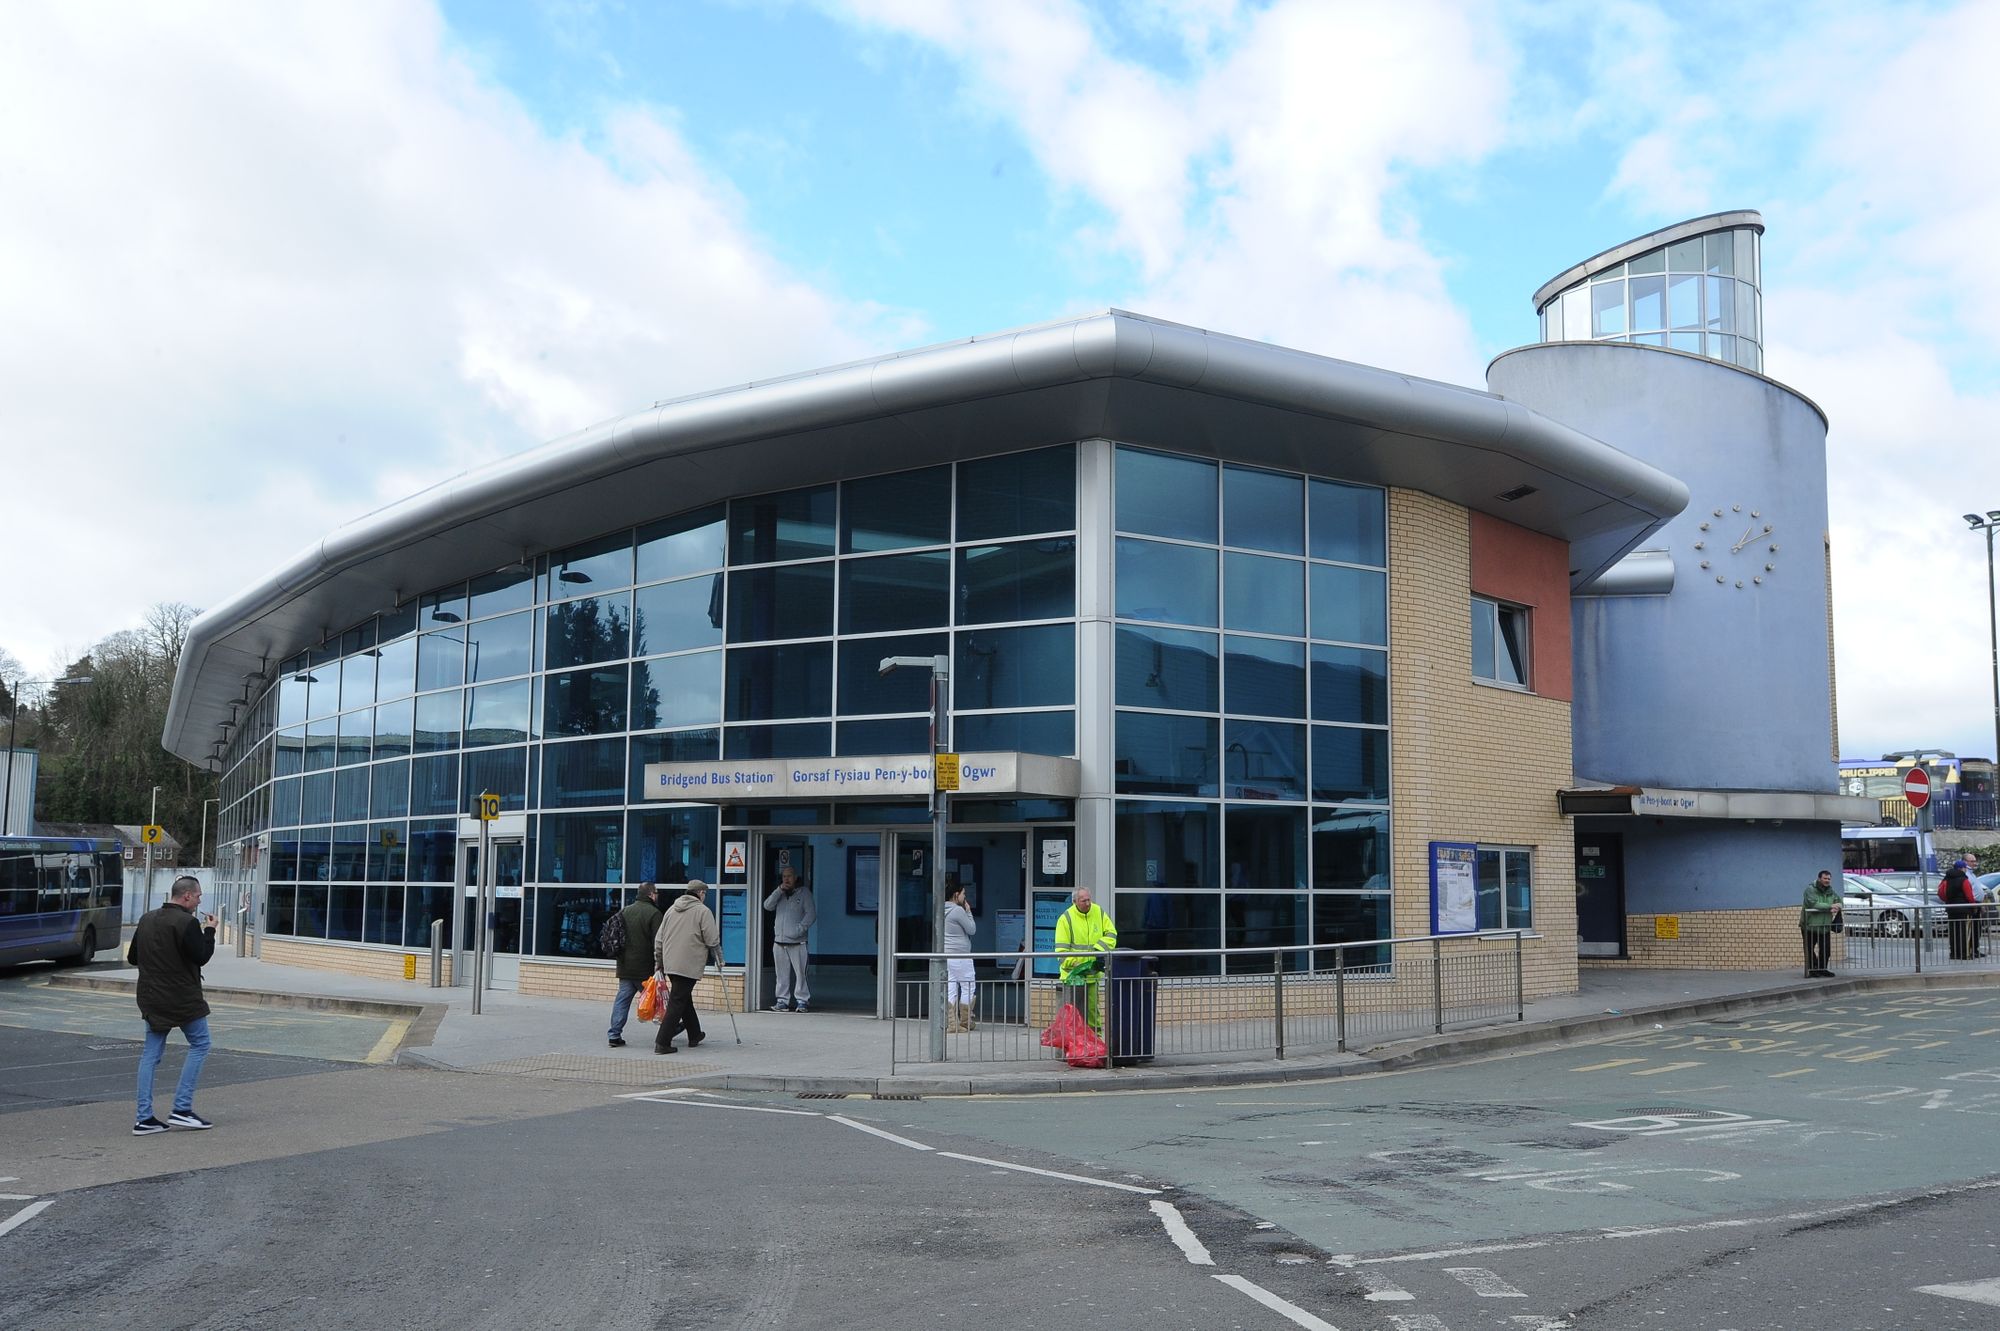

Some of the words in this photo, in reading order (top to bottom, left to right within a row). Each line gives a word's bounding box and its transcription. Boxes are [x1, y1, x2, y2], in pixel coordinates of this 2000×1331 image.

[660, 772, 707, 788] Bridgend
[711, 772, 730, 785] Bus
[734, 771, 773, 784] Station
[793, 768, 830, 783] Gorsaf
[834, 769, 870, 784] Fysiau
[875, 766, 933, 783] Pen-y-bo
[962, 765, 996, 782] Ogwr
[483, 799, 498, 816] 10
[148, 828, 157, 840] 9
[1885, 995, 2000, 1007] BU
